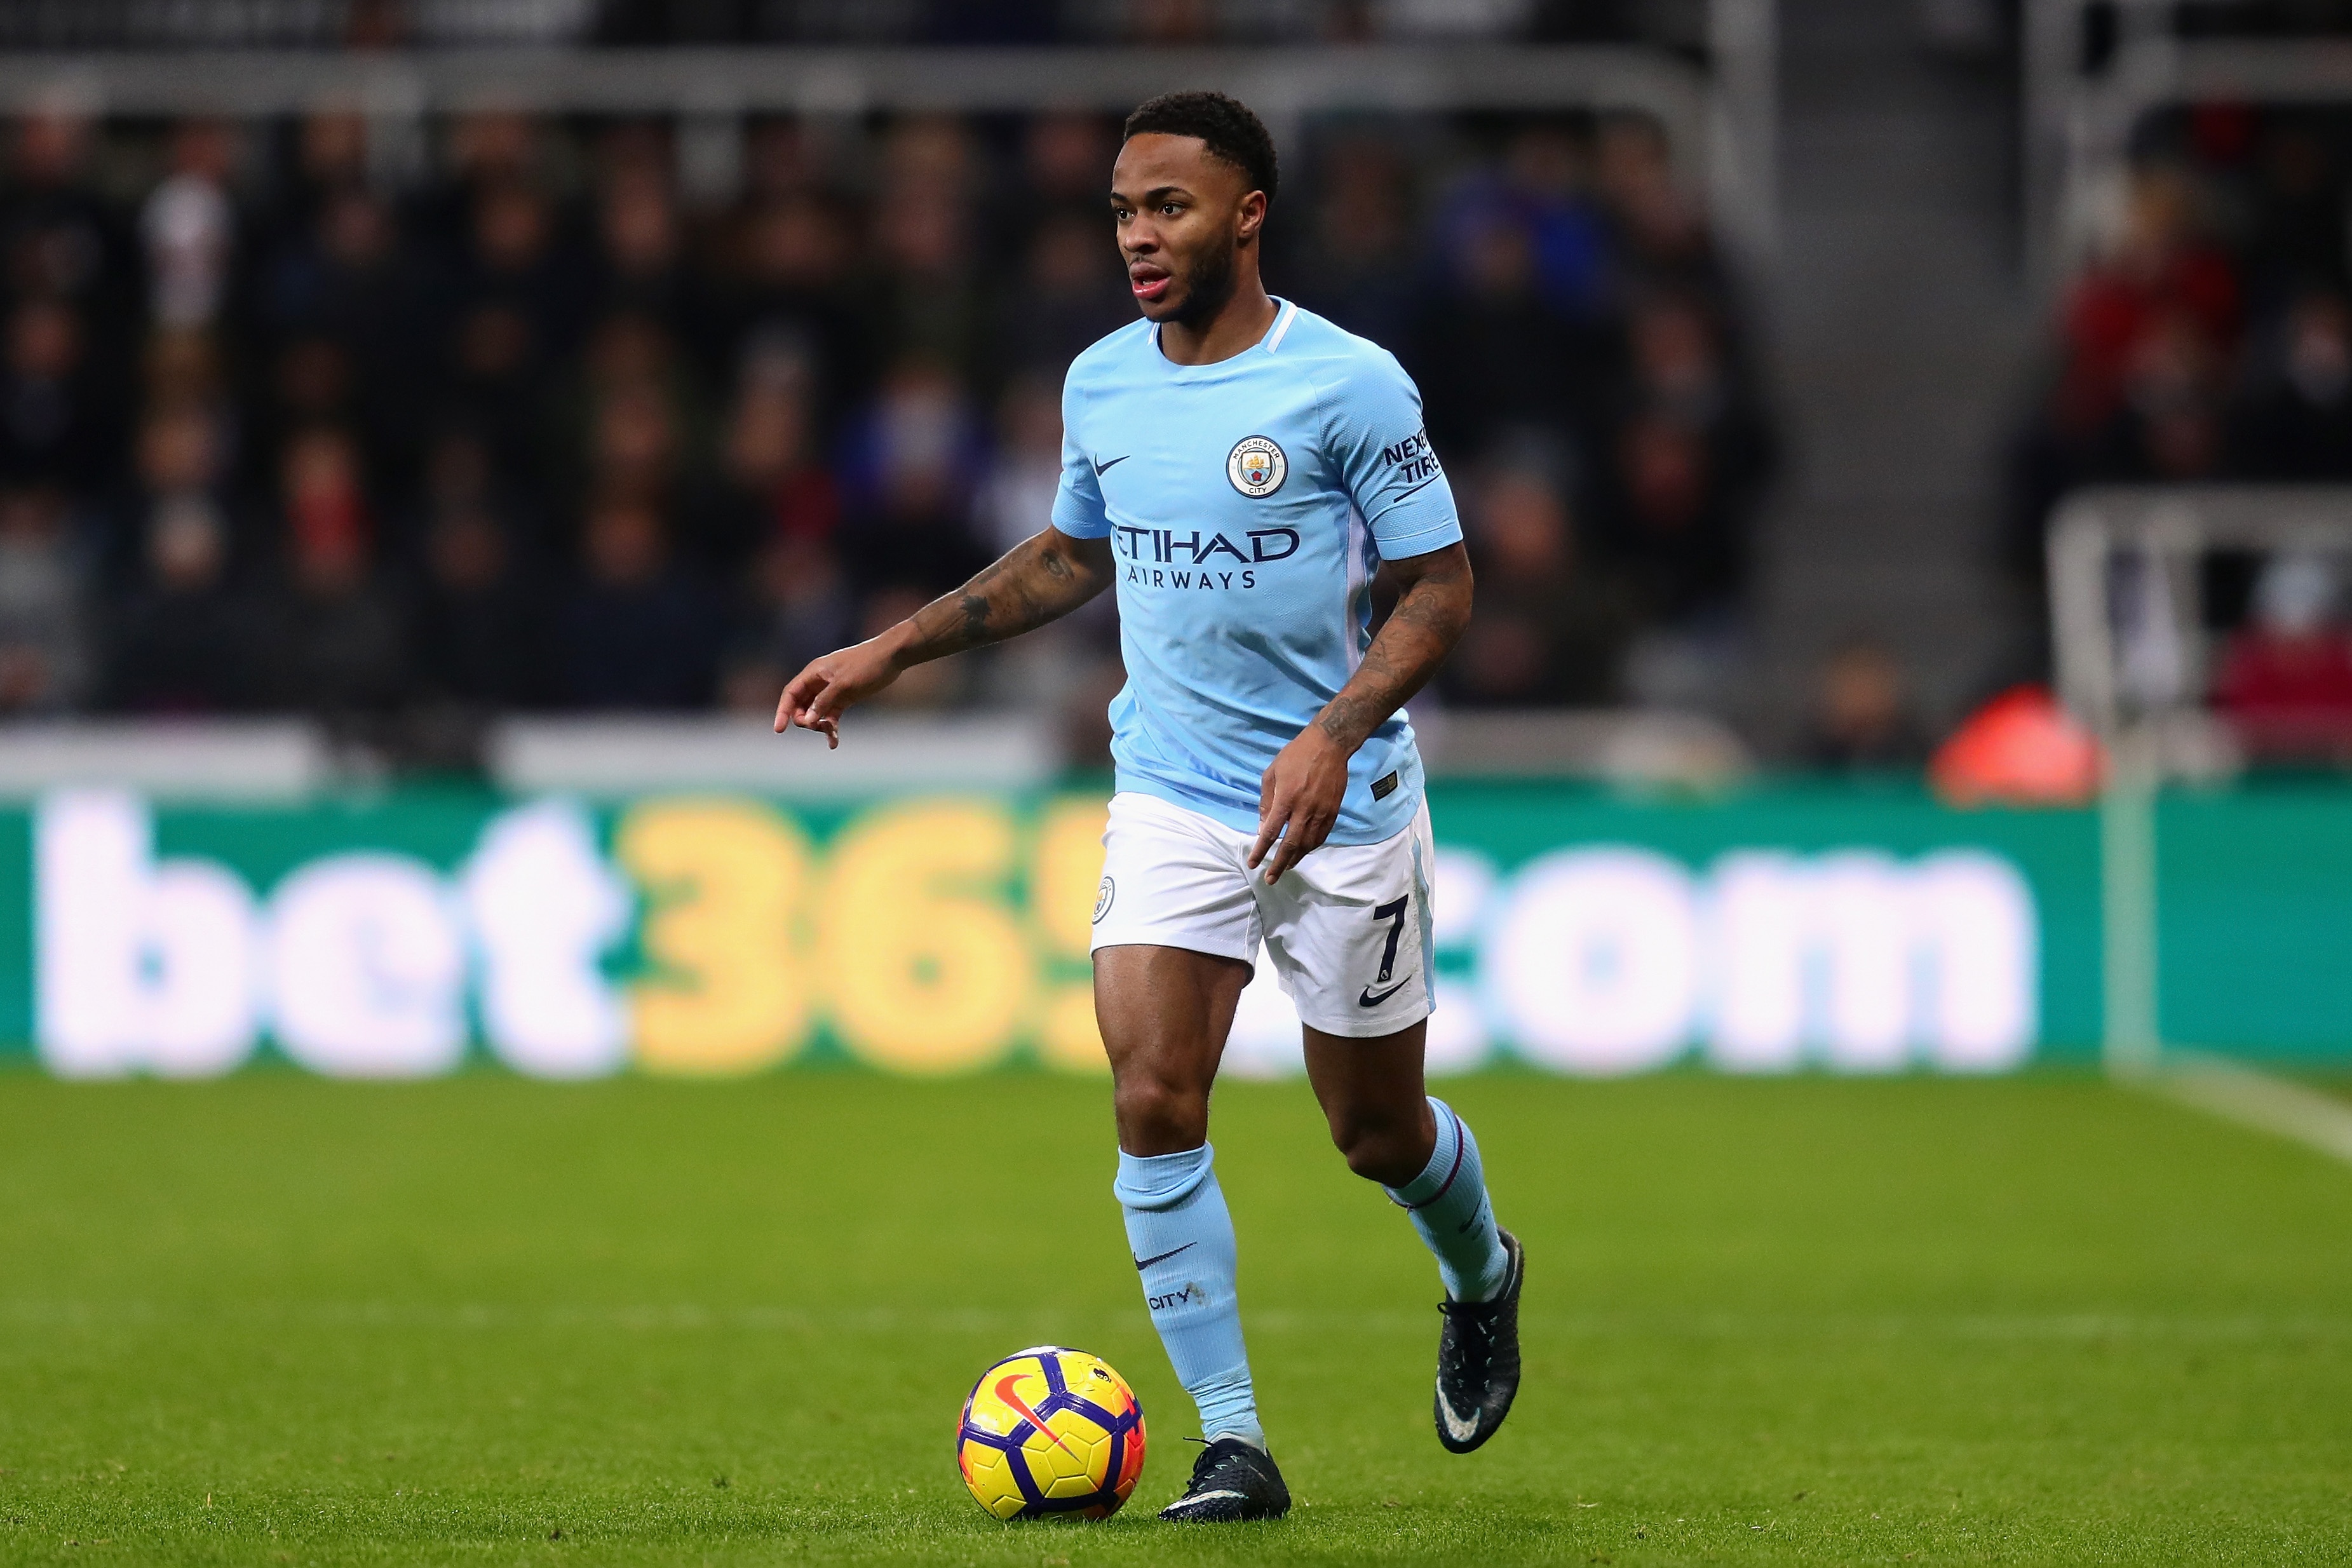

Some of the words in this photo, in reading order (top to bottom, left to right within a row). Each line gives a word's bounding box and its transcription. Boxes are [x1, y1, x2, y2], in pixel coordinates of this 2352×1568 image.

[1233, 440, 1280, 459] MANCHESTER
[1400, 450, 1439, 483] TIRE
[1127, 565, 1256, 590] AIRWAYS
[1372, 893, 1409, 983] 7
[1149, 1288, 1191, 1310] CITY
